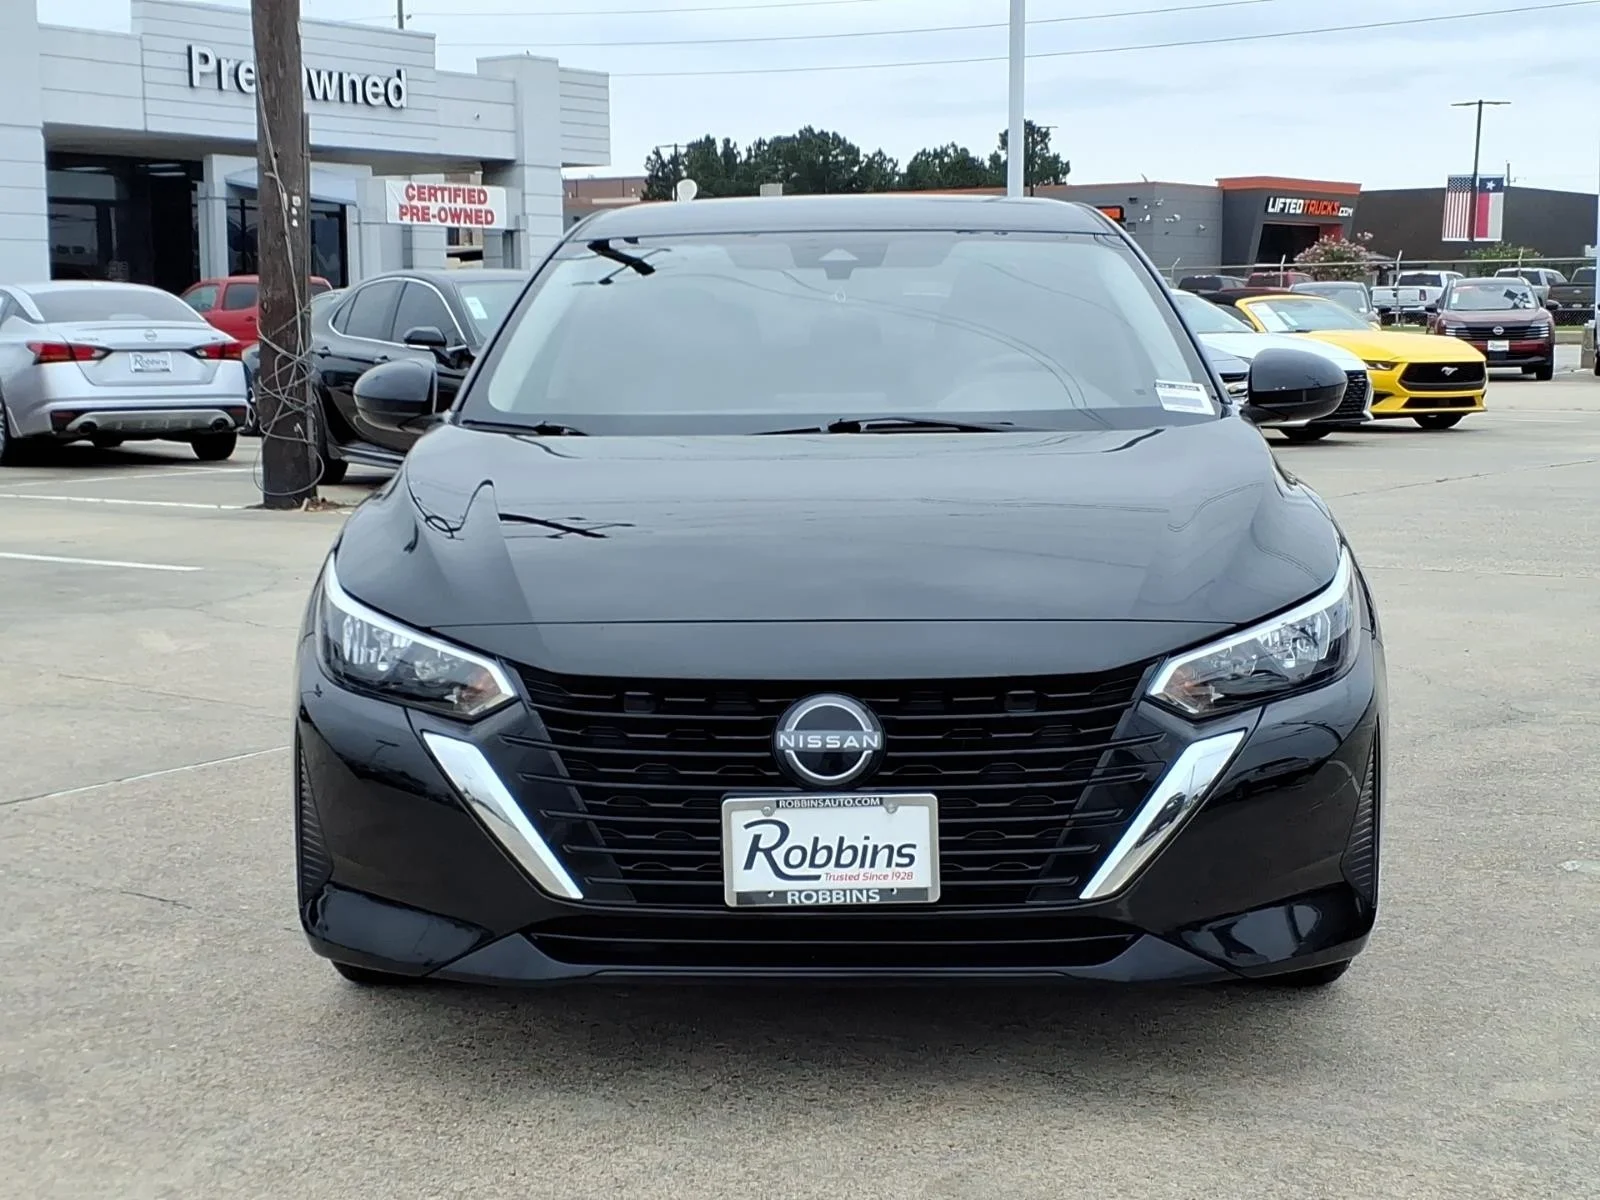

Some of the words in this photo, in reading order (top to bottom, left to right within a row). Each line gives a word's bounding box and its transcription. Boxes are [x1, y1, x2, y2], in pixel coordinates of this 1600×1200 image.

[405, 184, 488, 205] CERTIFIED
[398, 204, 495, 225] PRE-OWNED
[780, 734, 878, 748] NISSAN
[779, 797, 880, 809] ROBBINSAUTO.COM
[743, 819, 917, 881] Robbins
[825, 871, 860, 881] Trusted
[863, 871, 888, 881] Since
[891, 871, 913, 881] 1928
[787, 888, 880, 904] ROBBINS
